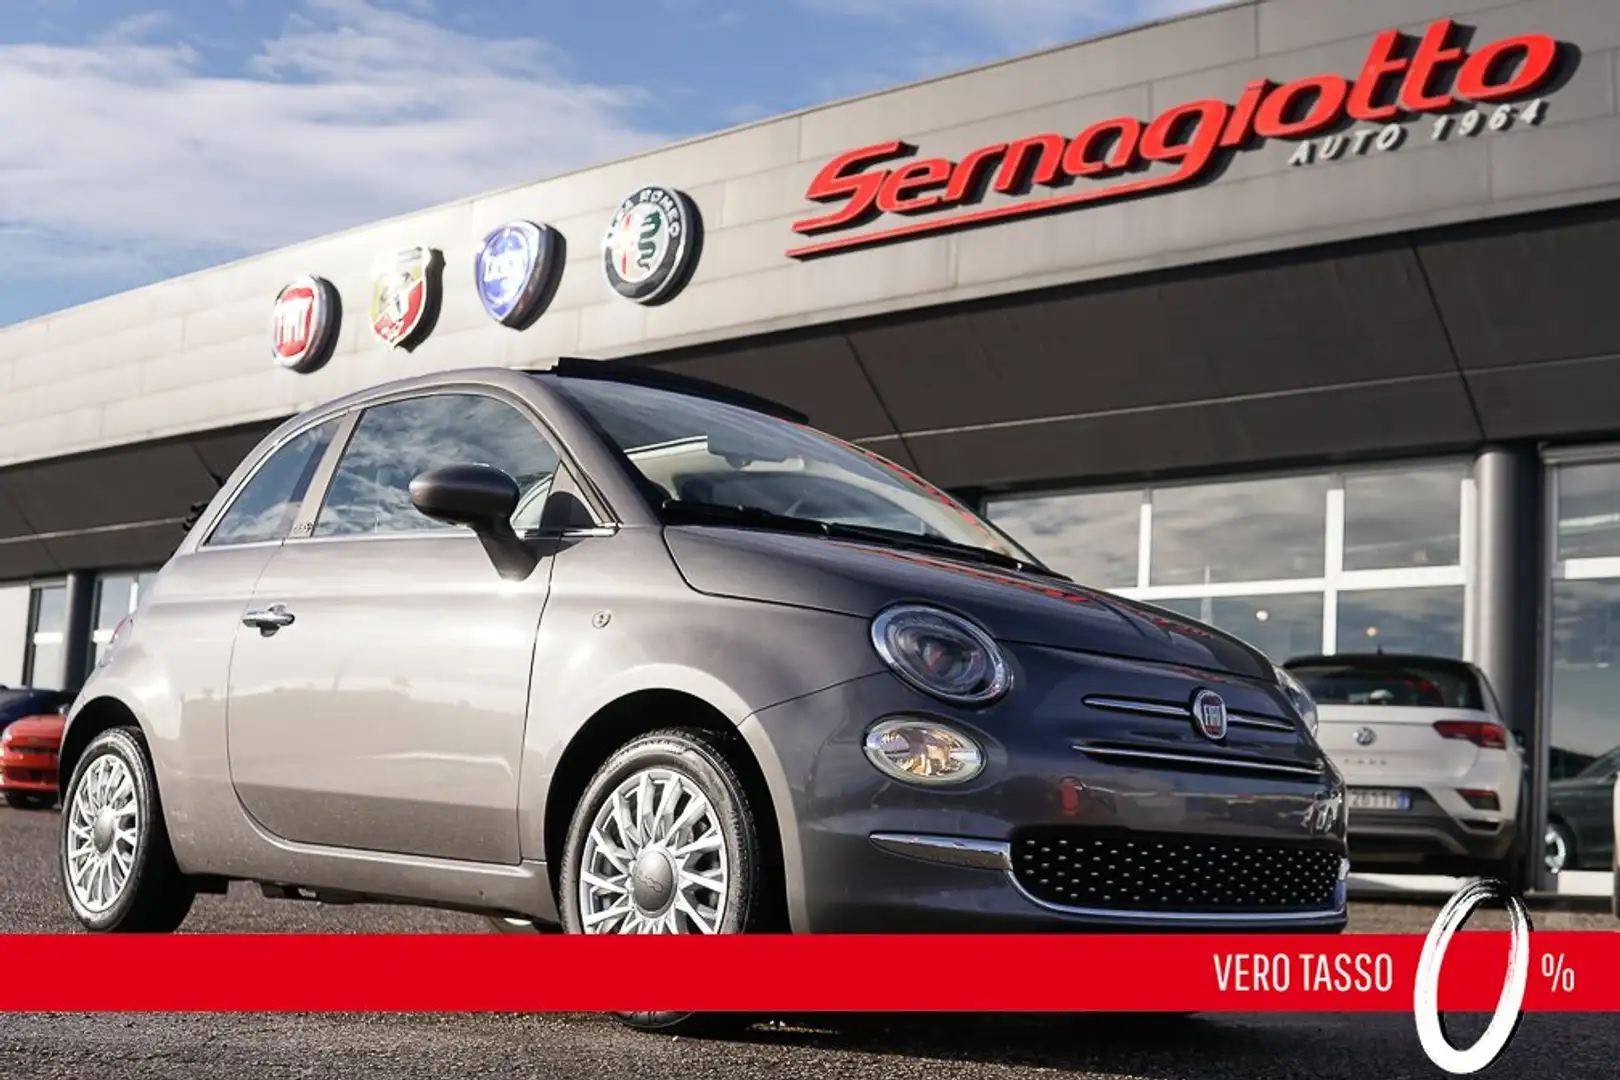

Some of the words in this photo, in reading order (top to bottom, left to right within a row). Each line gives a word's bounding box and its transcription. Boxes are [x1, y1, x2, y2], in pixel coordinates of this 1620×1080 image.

[786, 19, 1558, 258] Sernagiotto
[1289, 123, 1401, 166] AUTO
[1431, 98, 1543, 142] 1964
[639, 188, 681, 238] ROMEO
